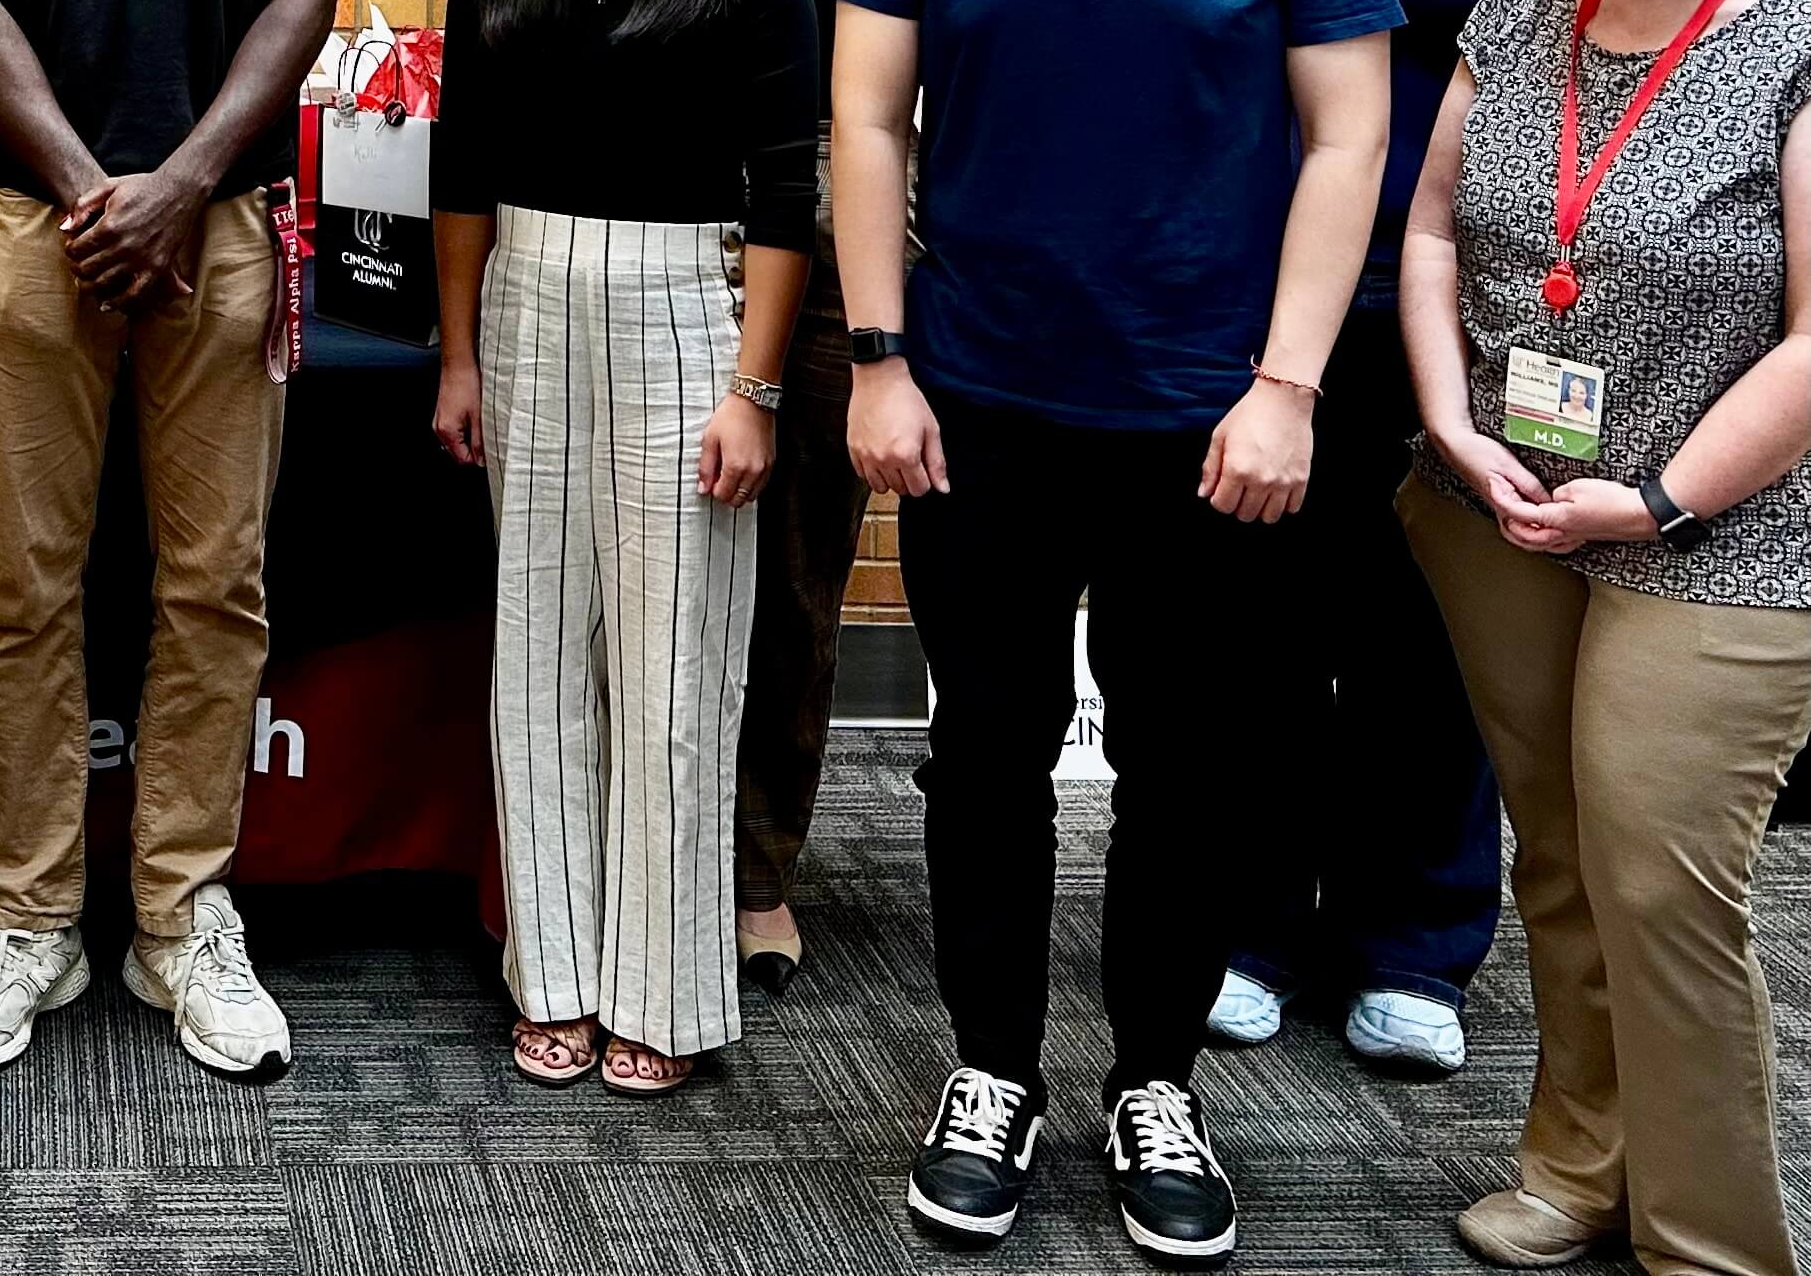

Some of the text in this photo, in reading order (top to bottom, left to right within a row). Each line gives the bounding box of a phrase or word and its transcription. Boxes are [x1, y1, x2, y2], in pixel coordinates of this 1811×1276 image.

[286, 236, 299, 263] Psi
[341, 251, 403, 277] CINCINNATI
[288, 267, 301, 314] Alpha
[1534, 429, 1566, 448] M.D.
